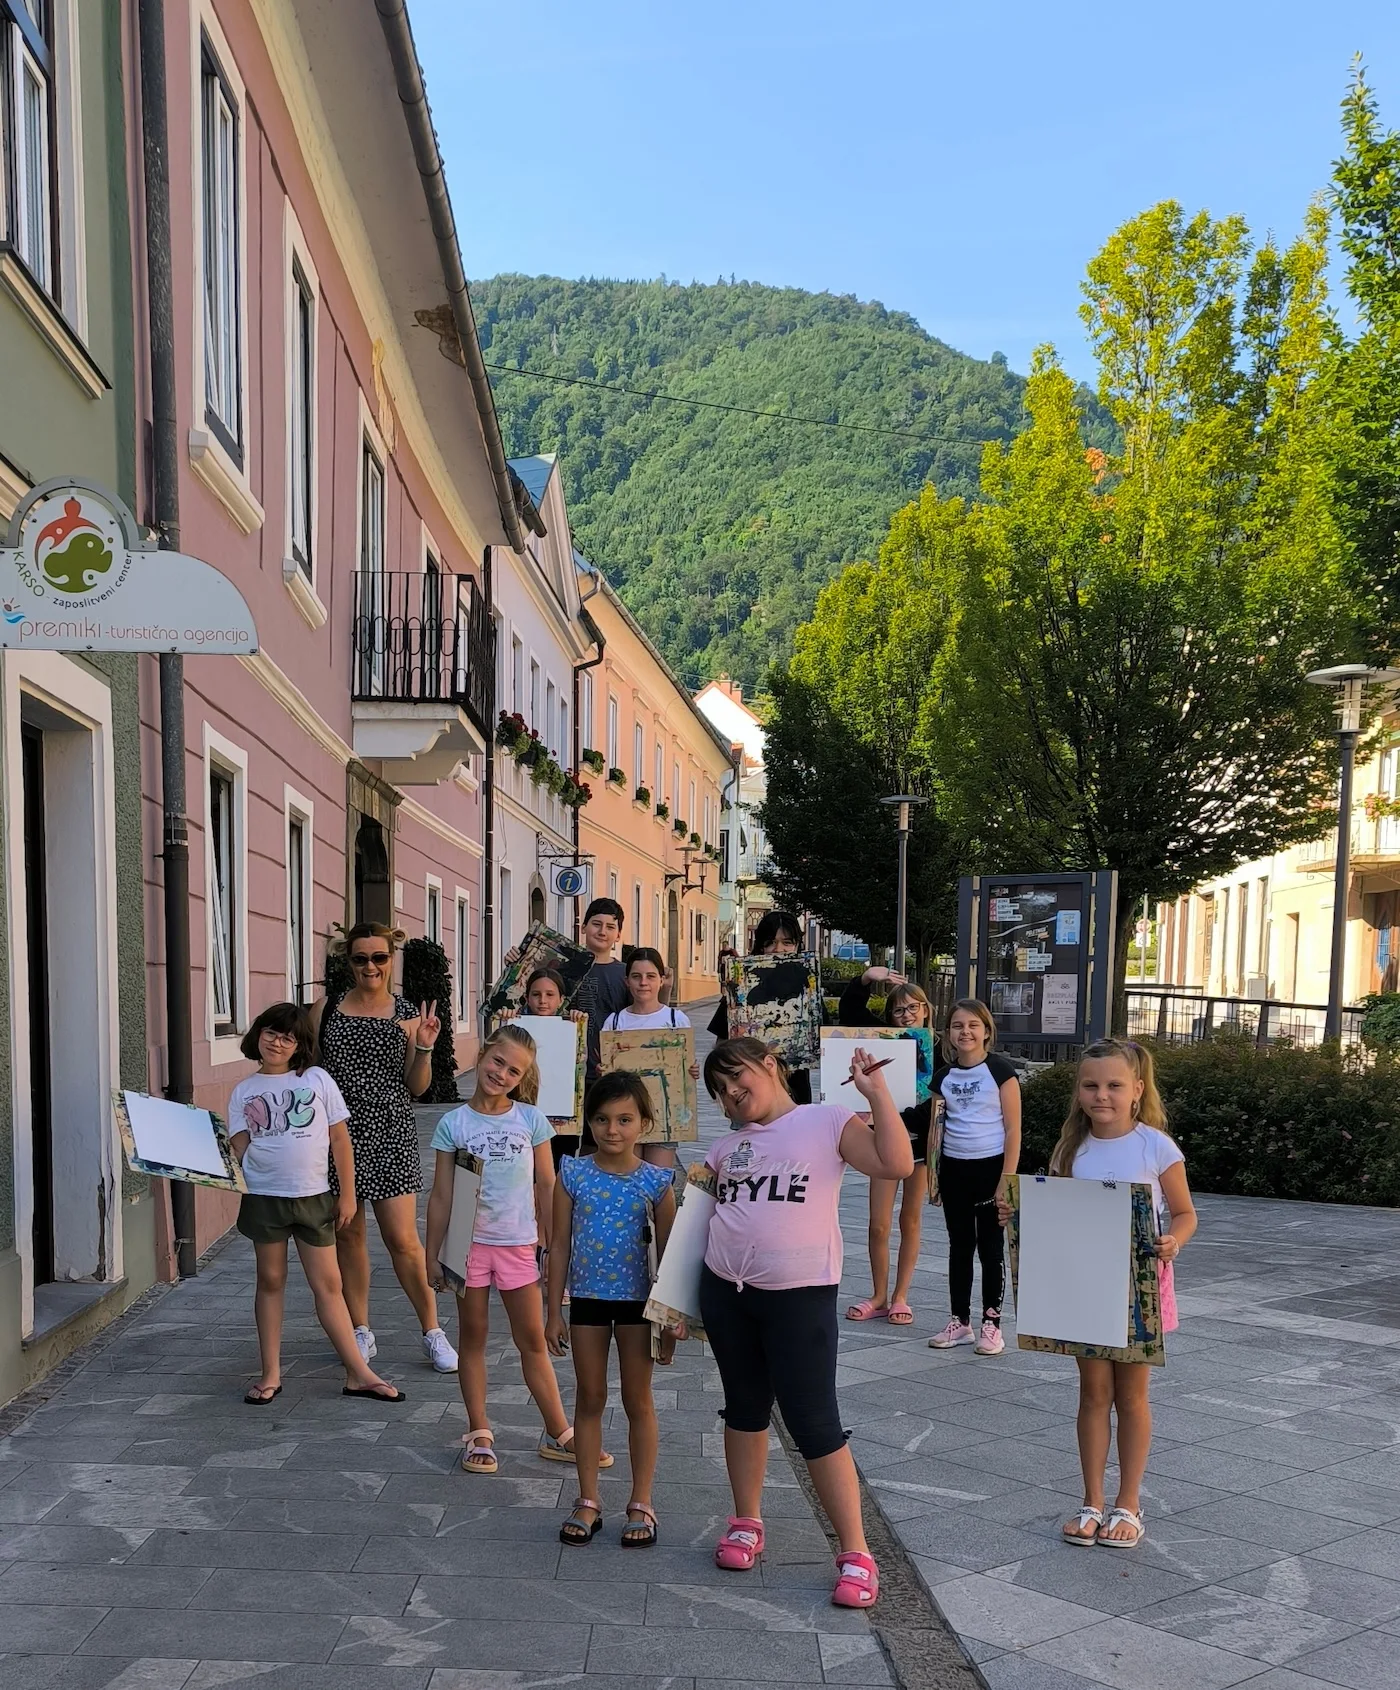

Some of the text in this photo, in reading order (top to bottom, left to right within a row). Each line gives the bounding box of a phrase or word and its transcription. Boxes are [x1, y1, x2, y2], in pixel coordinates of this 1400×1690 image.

[12, 551, 45, 597] KARSO
[53, 585, 116, 610] zaposlitveni
[115, 552, 132, 588] center
[19, 617, 101, 642] premiki
[184, 628, 249, 645] agencija
